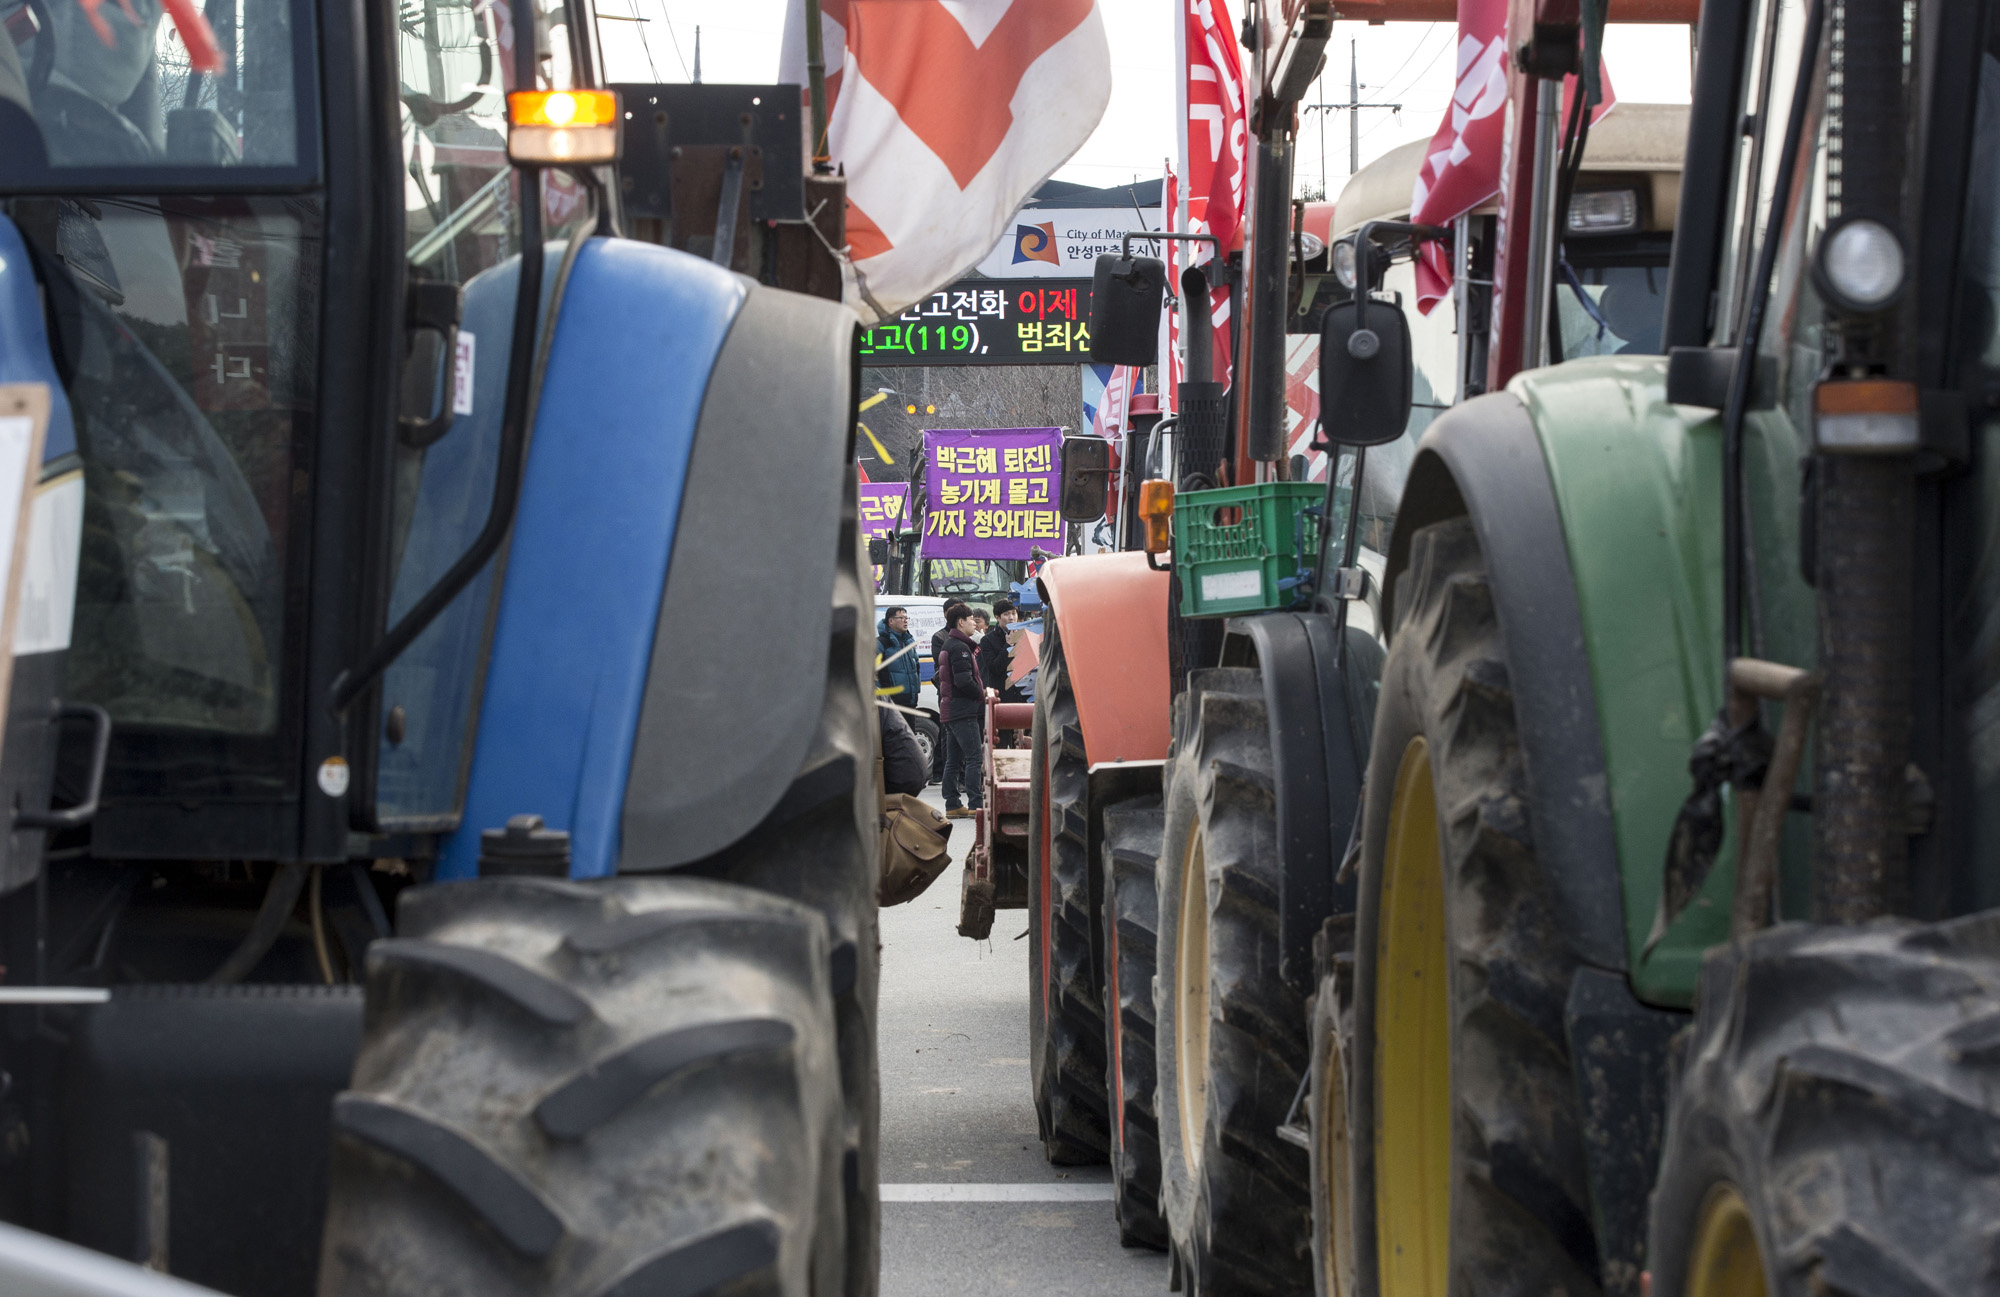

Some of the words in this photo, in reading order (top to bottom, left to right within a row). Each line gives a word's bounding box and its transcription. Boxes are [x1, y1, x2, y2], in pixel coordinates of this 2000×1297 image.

[1067, 229, 1088, 241] City
[1091, 229, 1102, 239] of
[1105, 229, 1130, 239] Mas
[1018, 288, 1077, 320] 이제
[936, 445, 998, 473] 박근혜
[1004, 444, 1052, 473] 퇴진!
[940, 479, 1001, 505] 농기계
[1008, 478, 1049, 505] 몰고
[858, 495, 908, 521] 근혜
[927, 509, 966, 537] 가자
[972, 508, 1060, 539] 청와대로!
